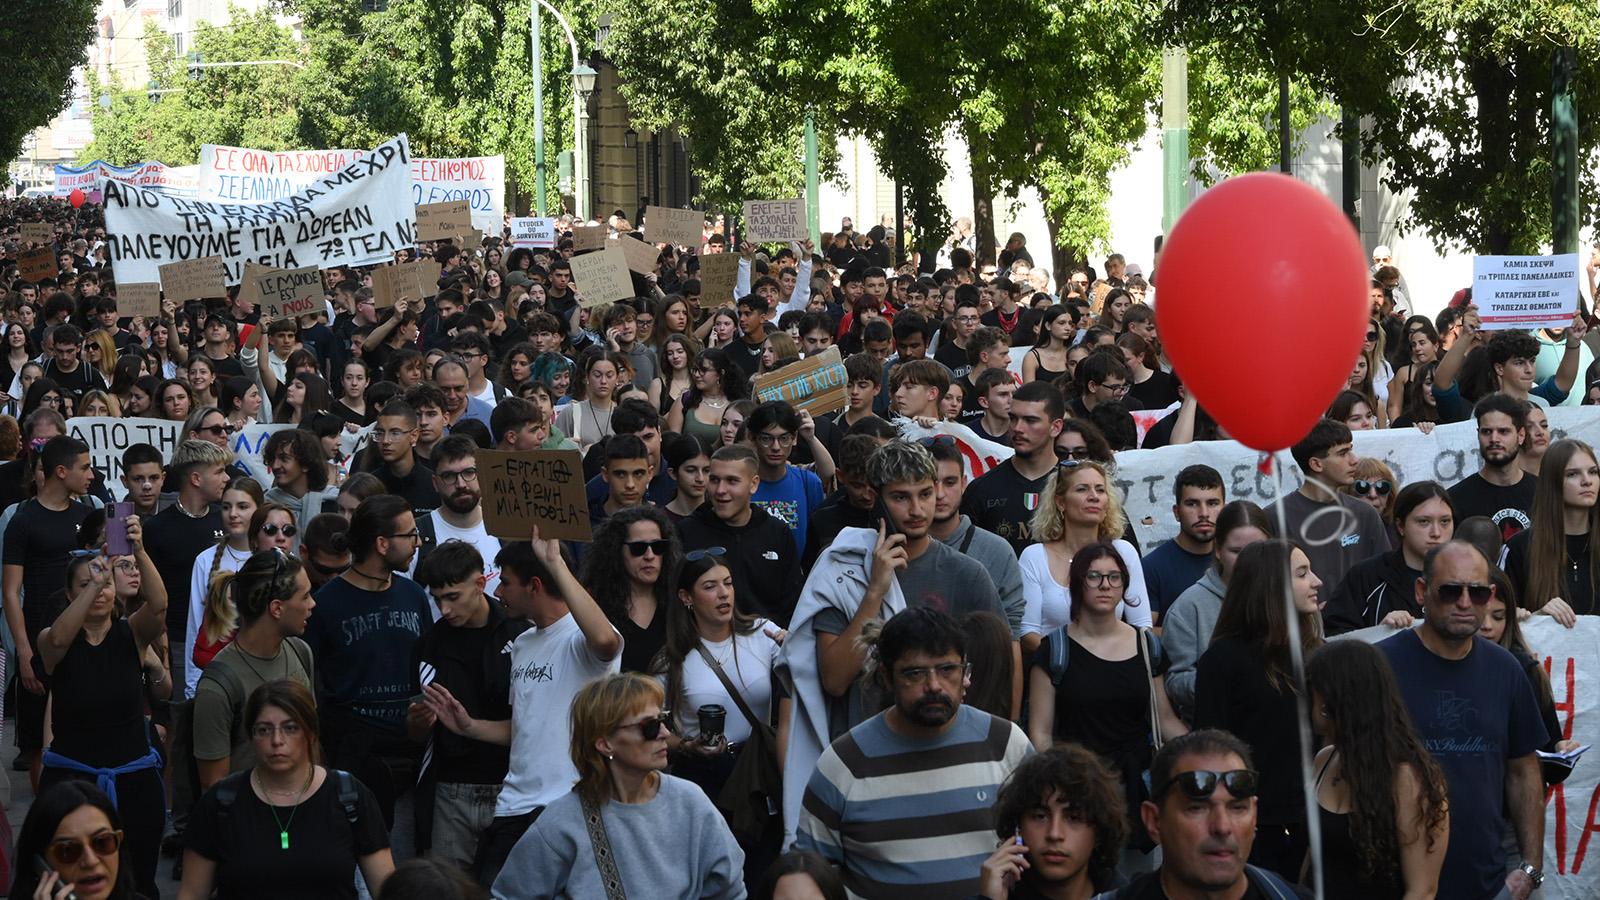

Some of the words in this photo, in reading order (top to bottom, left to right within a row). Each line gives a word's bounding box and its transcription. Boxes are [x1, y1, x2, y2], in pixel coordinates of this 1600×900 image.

[214, 148, 238, 172] ΣΕ
[242, 152, 269, 174] ΟΛΑ
[275, 154, 294, 173] ΤΑ
[296, 153, 346, 173] ΣΧΟΛΕΙΑ
[103, 179, 159, 209] ΑΠΟ
[162, 194, 217, 214] ΤΗΝ
[323, 139, 407, 190] ΜΕΧΡΙ
[176, 212, 213, 232] ΤΗ
[518, 220, 545, 228] ETUDIER
[760, 214, 798, 226] ΣΧΟΛΕΙΑ
[107, 230, 241, 261] ΠΑΛΕΥΟΥΜΕ
[252, 225, 286, 252] ΓΙΑ
[296, 204, 373, 244] ΔΩΡΕΑΝ
[516, 232, 549, 240] SURVIVRE?
[348, 230, 395, 257] ΓΕΛ
[1503, 260, 1528, 268] ΚΑΜΙΑ
[1529, 260, 1555, 268] ΣΚΕΨΗ
[260, 278, 276, 296] LE
[276, 271, 319, 292] MONDE
[1488, 273, 1519, 281] ΤΡΙΠΛΕΣ
[1521, 271, 1575, 281] ΠΑΝΕΛΛΑΔΙΚΕΣ!
[280, 287, 297, 301] EST
[1495, 291, 1537, 299] ΚΑΤΑΡΓΗΣΗ
[1537, 290, 1550, 298] ΕΒΕ
[282, 294, 315, 317] NOUS
[1491, 304, 1528, 312] ΤΡΑΠΕΖΑΣ
[1529, 302, 1563, 311] ΘΕΜΑΤΩΝ
[758, 382, 786, 402] TAX
[784, 373, 814, 401] THE
[811, 361, 846, 392] RICH
[70, 422, 129, 450] ΑΠΟ
[136, 425, 176, 453] ΤΗ
[493, 478, 518, 496] ΜΙΑ
[521, 478, 563, 507] ΦΩΝΗ
[987, 498, 1008, 508] EA7
[496, 497, 524, 519] ΜΙΑ
[1493, 509, 1511, 524] HICH
[341, 612, 382, 647] STAFF
[387, 610, 421, 638] JEANS
